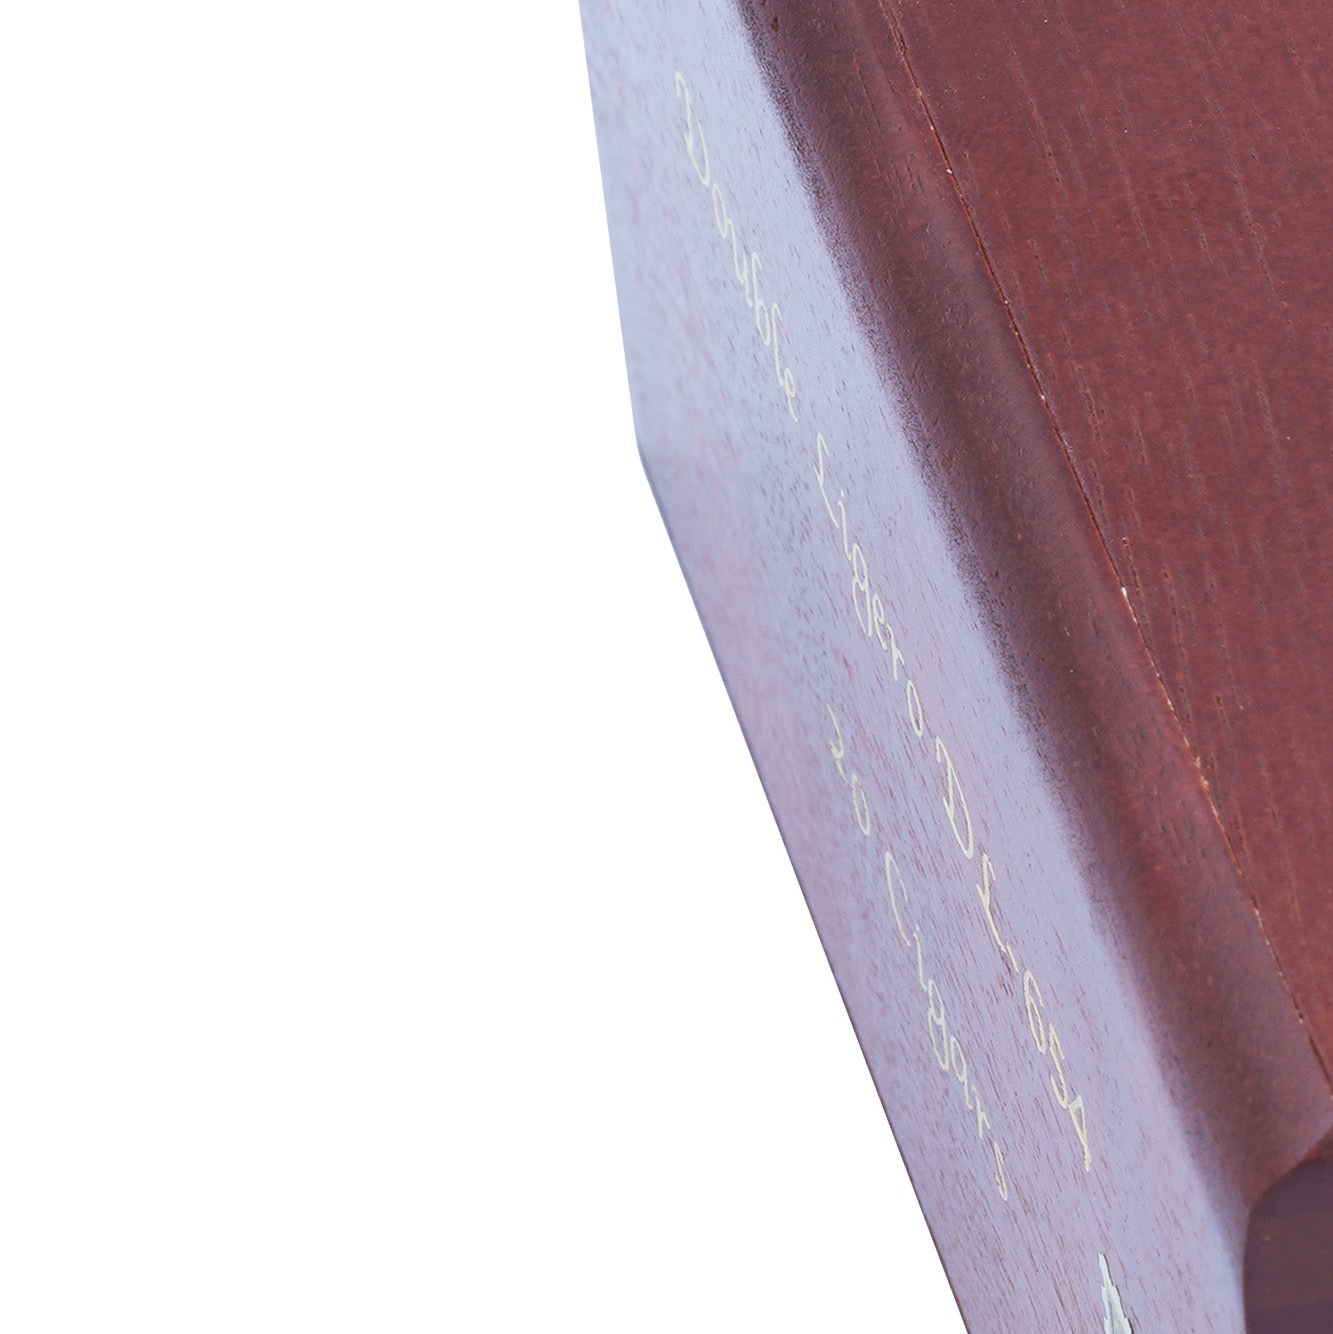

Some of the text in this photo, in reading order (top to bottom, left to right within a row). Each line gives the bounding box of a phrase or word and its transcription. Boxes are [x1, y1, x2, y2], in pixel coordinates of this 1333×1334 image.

[675, 70, 1090, 1172] Double Ligero DL-654
[885, 851, 1008, 1201] Cigars
